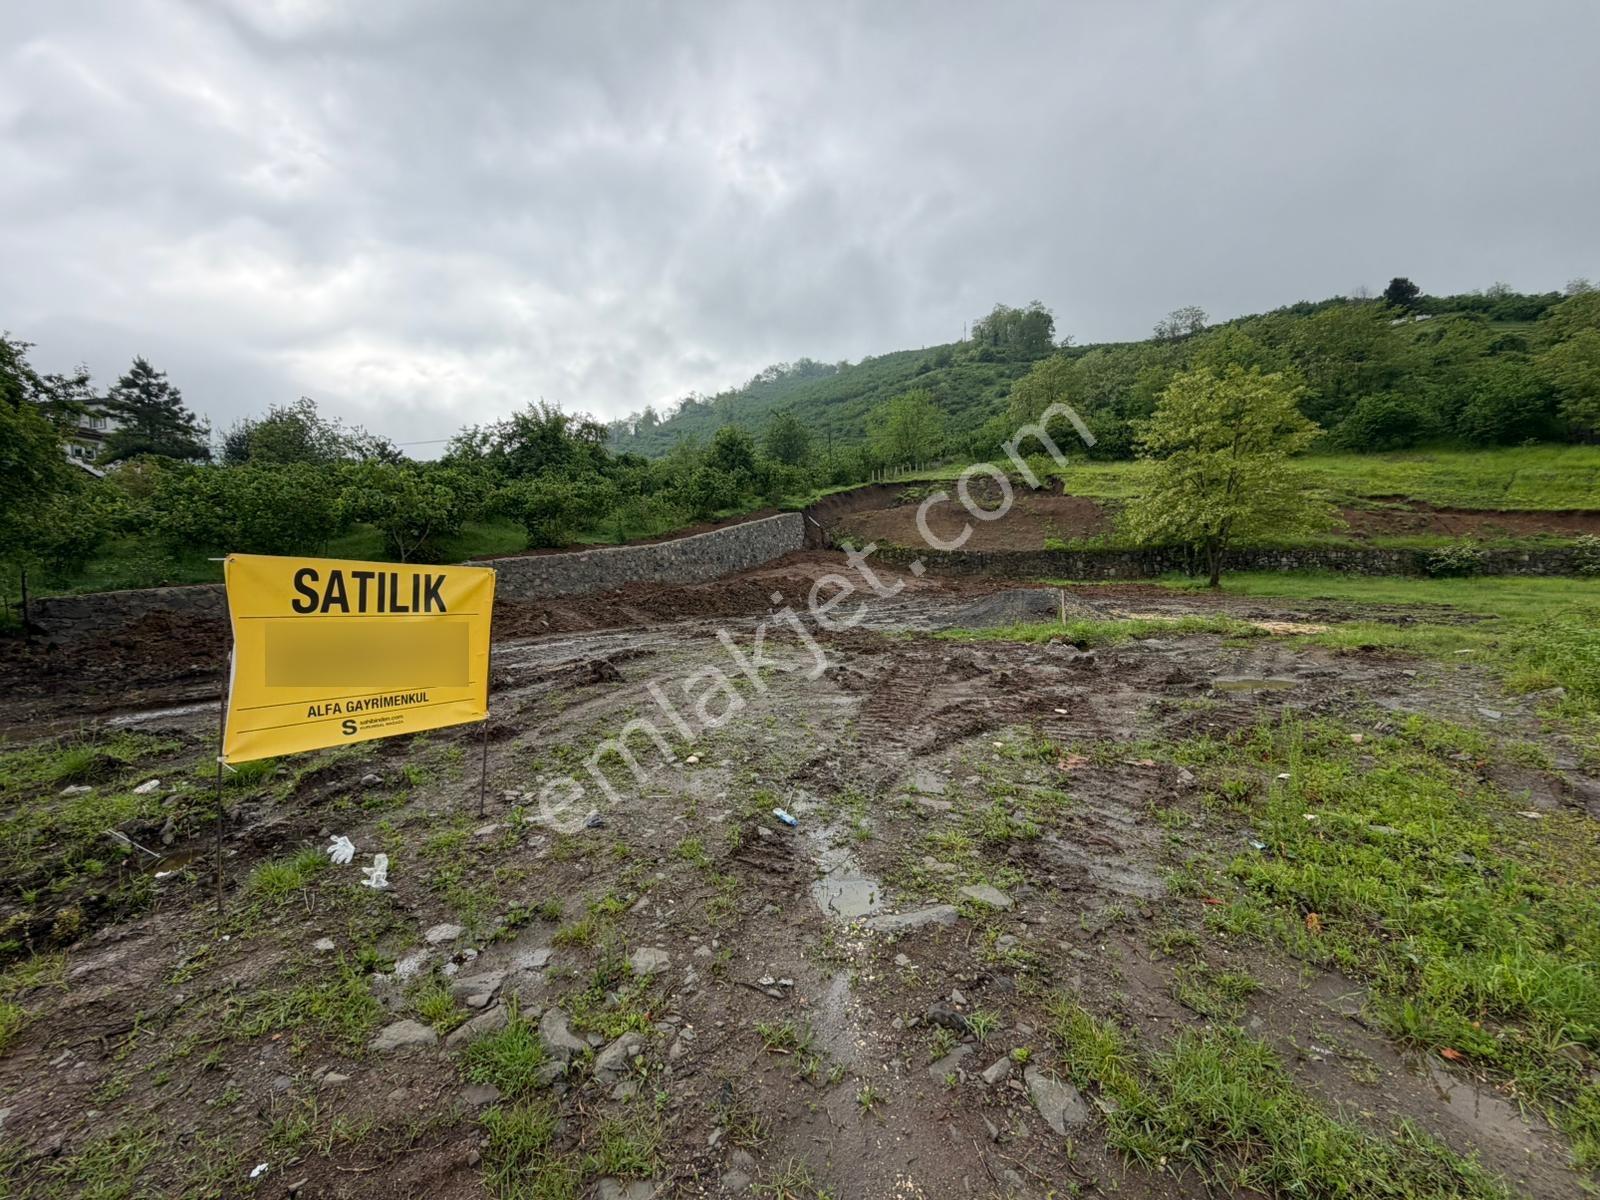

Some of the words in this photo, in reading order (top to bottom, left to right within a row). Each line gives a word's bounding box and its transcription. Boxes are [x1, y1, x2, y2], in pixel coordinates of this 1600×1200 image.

[291, 567, 447, 614] SATILIK
[307, 703, 342, 718] ALFA
[346, 692, 429, 713] GAYRİMENKUL
[341, 719, 358, 735] S
